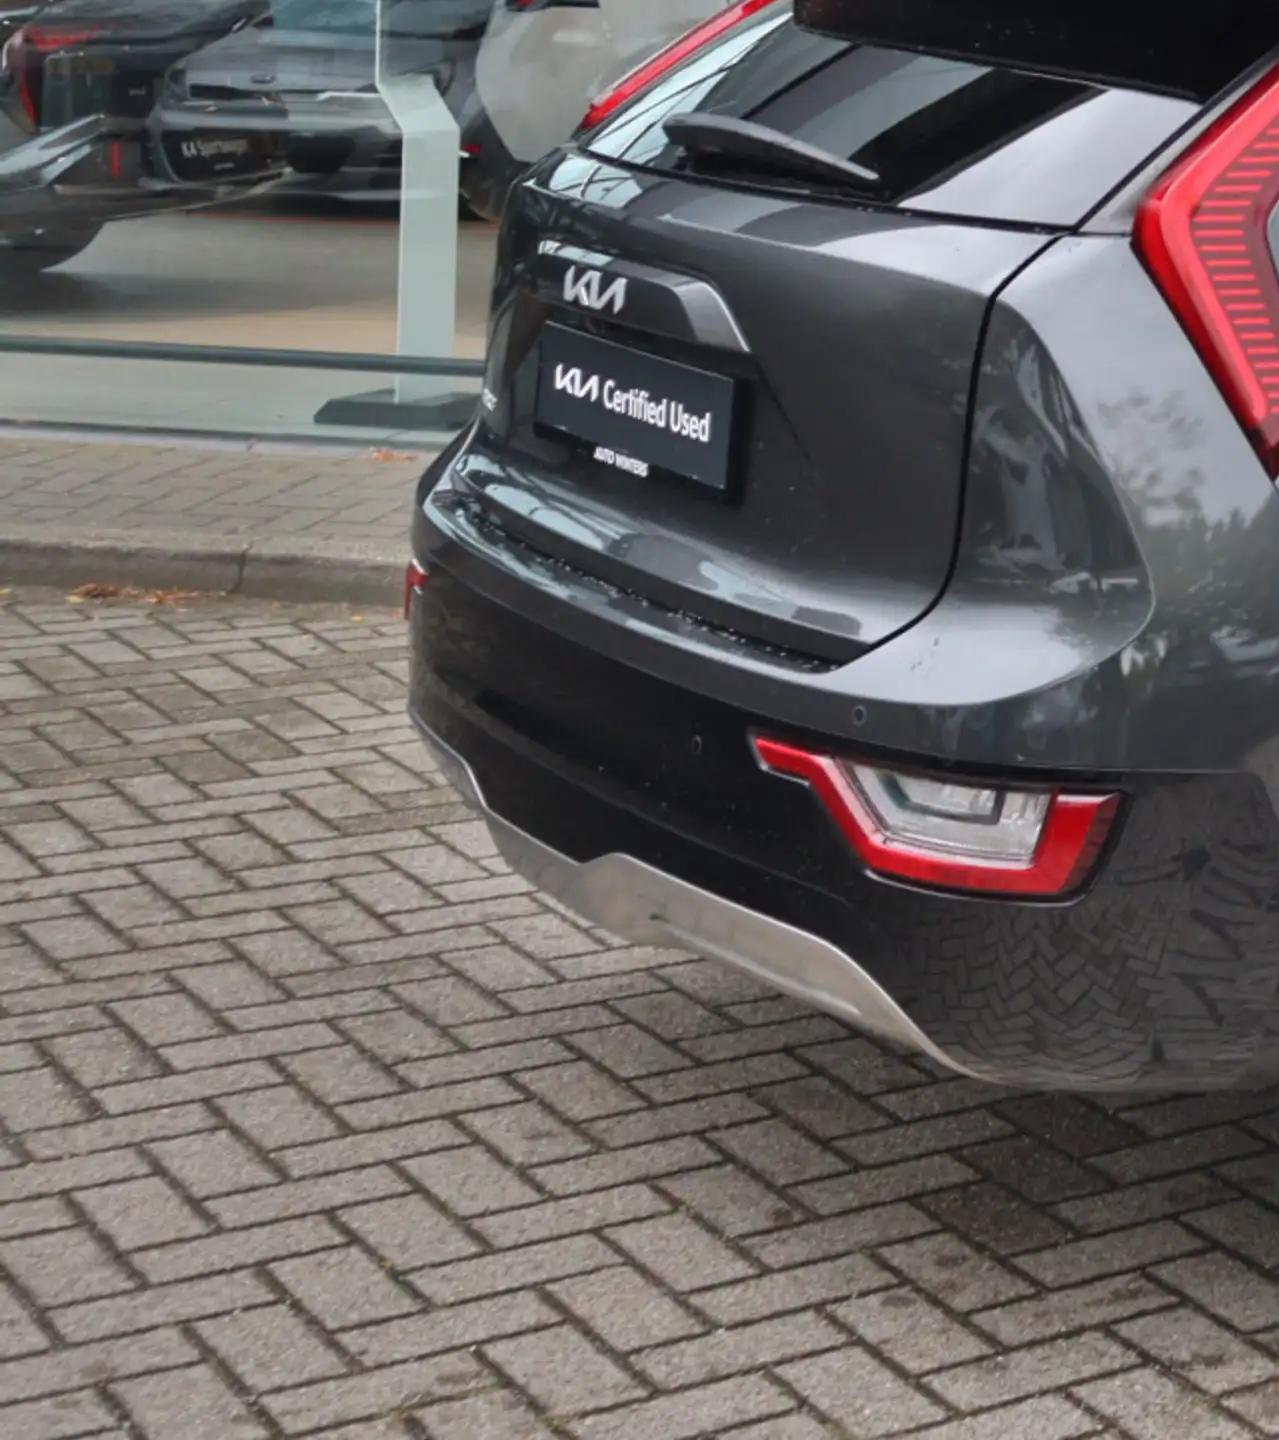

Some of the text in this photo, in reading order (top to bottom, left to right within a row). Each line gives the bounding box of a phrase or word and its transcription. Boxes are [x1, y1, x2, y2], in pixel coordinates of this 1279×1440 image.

[563, 264, 629, 315] KIA
[554, 363, 712, 443] KIA Certified Used
